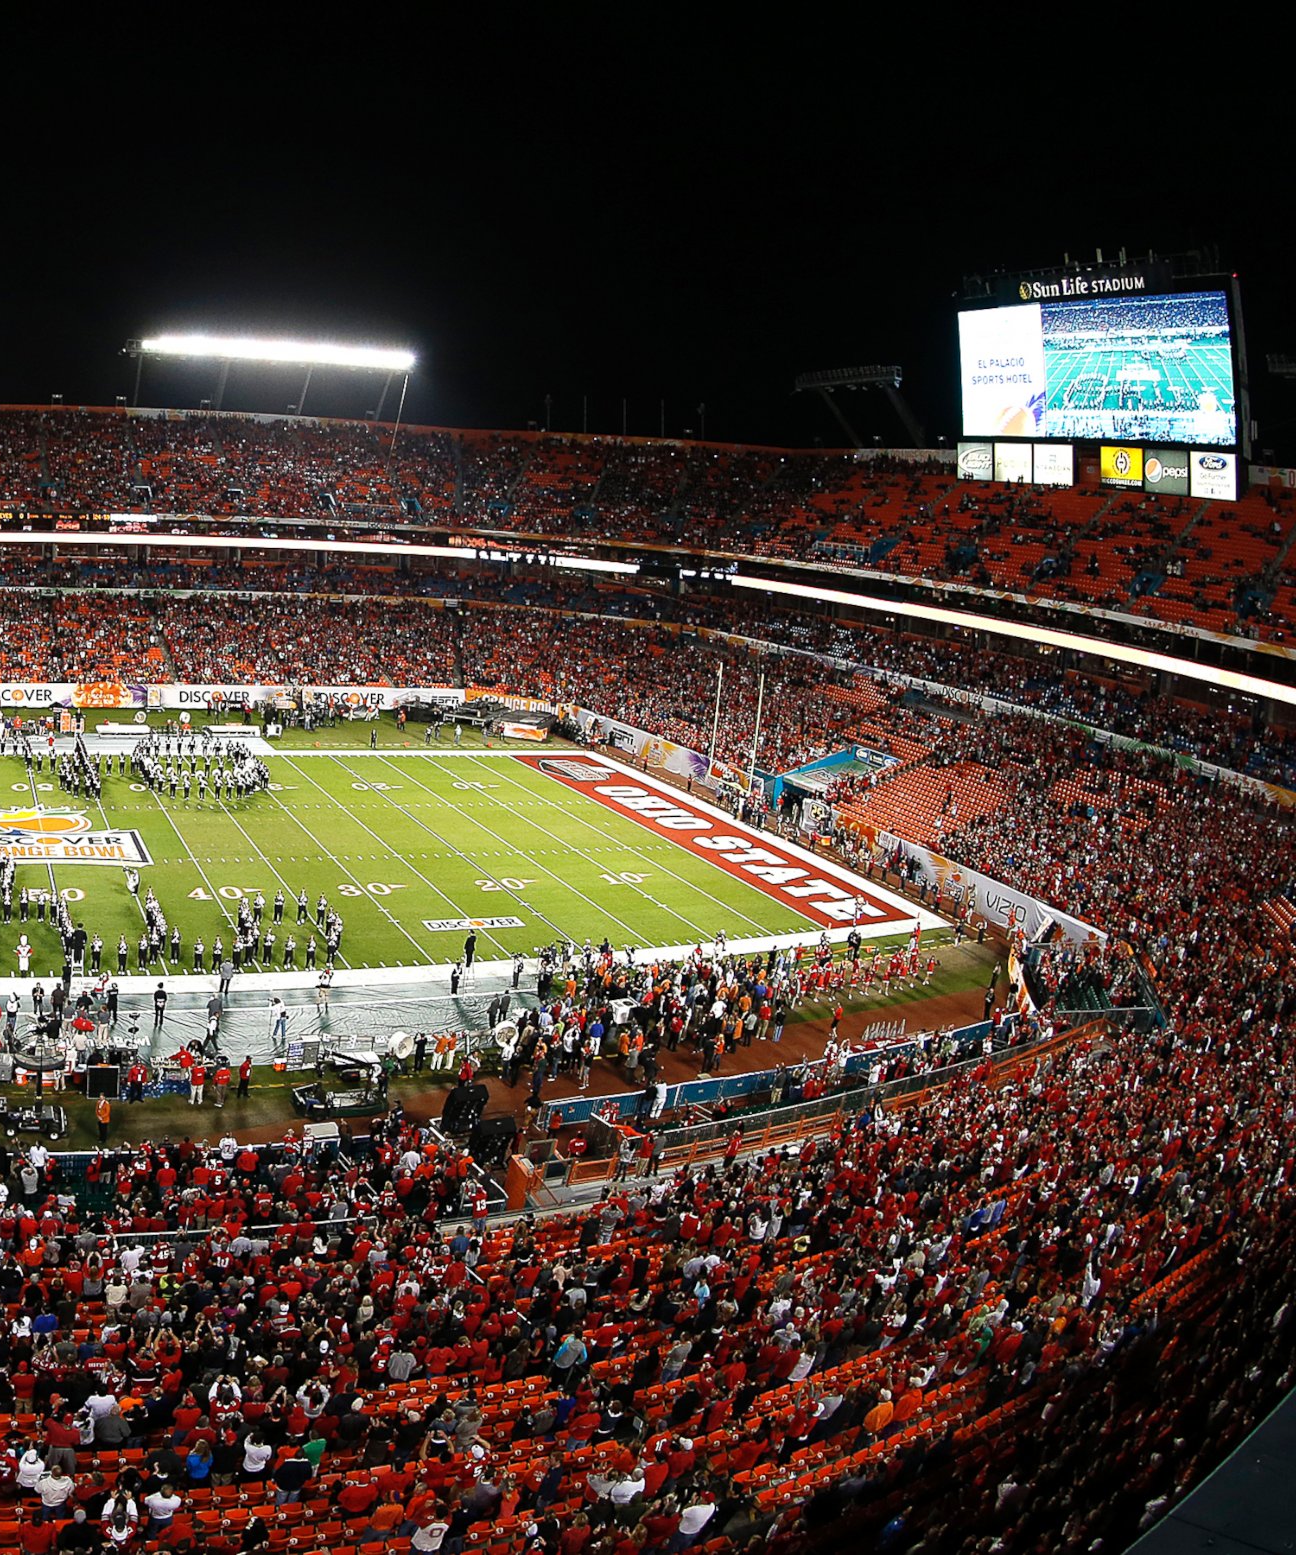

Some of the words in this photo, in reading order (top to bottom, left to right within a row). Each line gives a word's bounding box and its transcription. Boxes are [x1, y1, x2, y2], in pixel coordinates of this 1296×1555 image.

[1032, 282, 1060, 298] Sun
[1061, 277, 1089, 295] Life
[1092, 277, 1145, 293] STADIUM
[978, 360, 987, 368] EL
[990, 357, 1024, 368] PALACIO
[972, 374, 1004, 385] SPORTS
[1006, 373, 1032, 383] HOTEL
[1202, 455, 1224, 469] Ford
[1162, 466, 1188, 479] pepsi
[179, 690, 250, 703] DISCOVER
[320, 692, 385, 705] DISCOVER
[942, 686, 984, 705] DISCOVER
[482, 694, 528, 712] ORANGE
[64, 845, 133, 858] BOWL
[593, 785, 714, 831] OHIO
[691, 834, 888, 922] STATE
[474, 877, 526, 892] 20
[599, 871, 644, 885] 10
[187, 885, 245, 900] 40
[337, 882, 393, 897] 30
[985, 890, 1027, 923] VIZIO
[426, 917, 519, 930] DISCOVER
[224, 1144, 232, 1153] 7
[215, 1175, 222, 1185] 5
[475, 1200, 487, 1211] 13
[157, 1249, 170, 1260] 45
[377, 1359, 386, 1369] 5
[472, 1464, 483, 1478] 5
